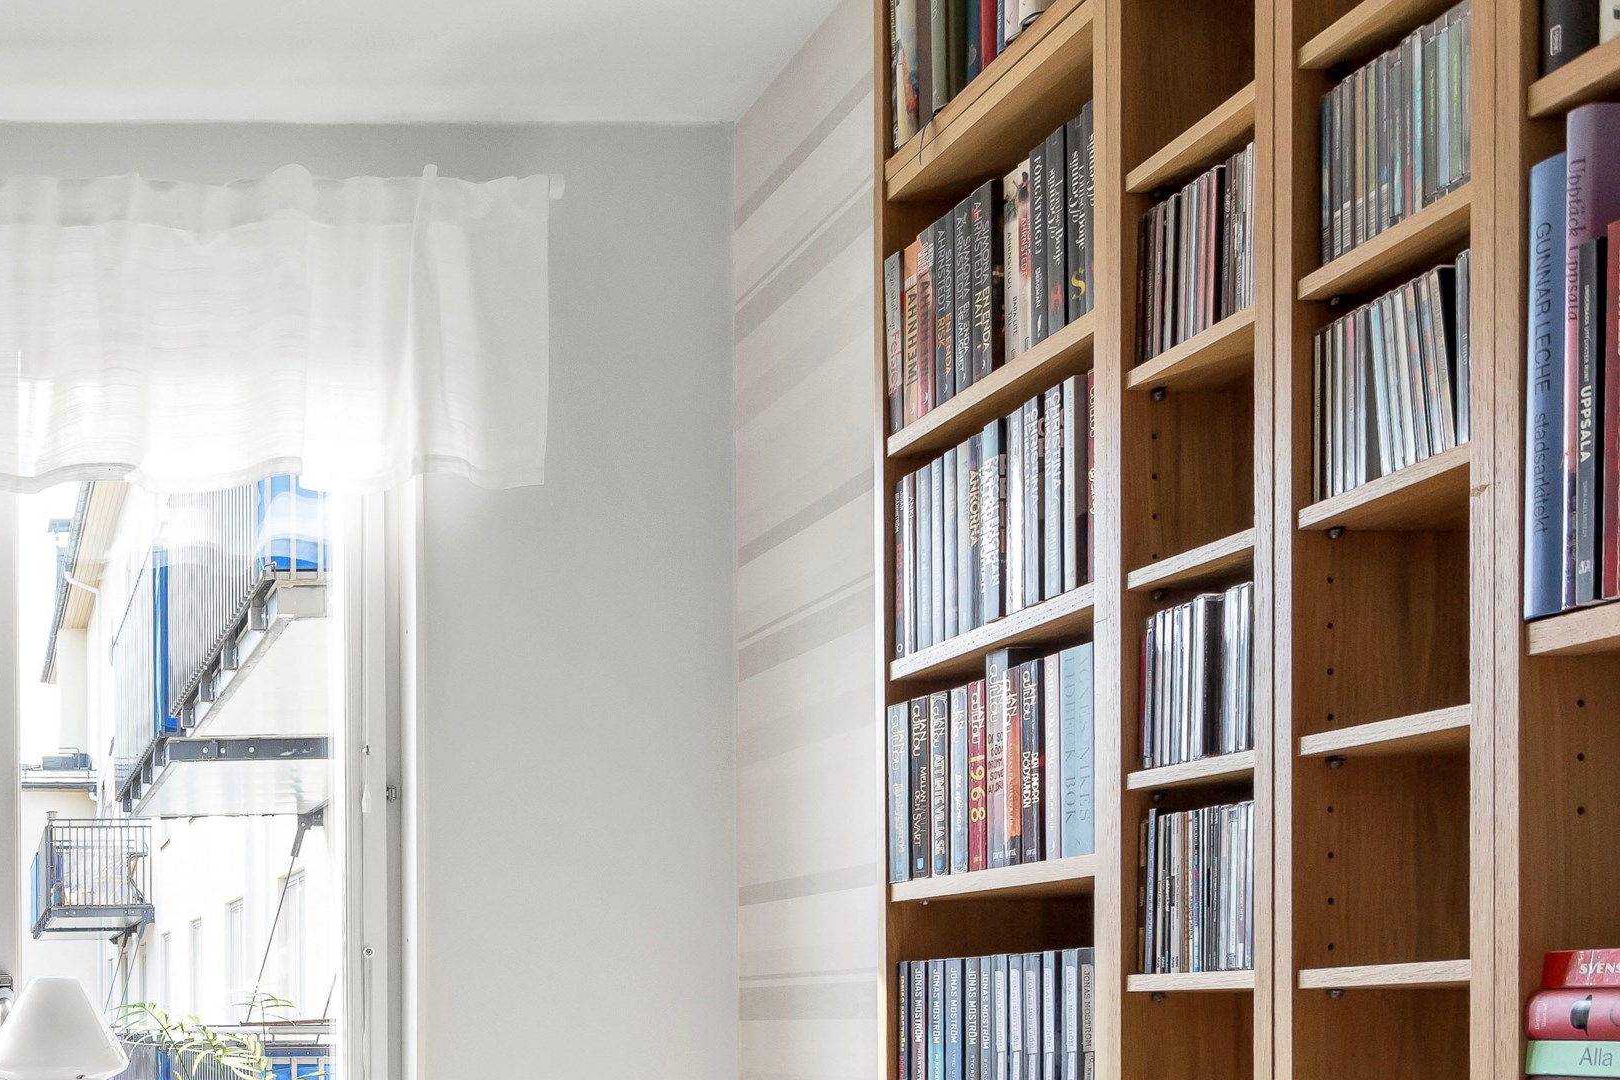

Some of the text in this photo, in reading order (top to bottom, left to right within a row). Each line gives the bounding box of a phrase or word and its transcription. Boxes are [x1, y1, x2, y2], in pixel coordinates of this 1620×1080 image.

[1567, 156, 1589, 238] Upptäck
[955, 218, 964, 301] AHRNSTEDT
[962, 236, 971, 301] SIMONA
[974, 202, 982, 286] AHRNSTEDT
[982, 221, 990, 281] SIMONA
[937, 230, 946, 312] AHRNSTEDT
[945, 250, 953, 309] SIMONA
[937, 317, 946, 347] RISK
[974, 291, 982, 328] NATT
[982, 286, 991, 353] EN ENDA
[1533, 221, 1552, 535] GUNNAR LECHE stadsarkitekt
[1051, 392, 1061, 491] CHRISTINA
[1580, 385, 1593, 463] UPPSALA
[972, 693, 980, 744] GUILLOU
[989, 664, 999, 722] GUILLOU
[1023, 671, 1031, 720] GUILLOU
[892, 715, 900, 770] GUILLOU
[913, 706, 921, 757] GUILLOU
[932, 706, 940, 748] GUILLOU
[935, 754, 944, 777] ATT
[971, 755, 986, 822] 1968
[935, 778, 944, 805] INTE
[1065, 777, 1077, 824] BOK
[913, 814, 922, 848] SVART
[935, 839, 944, 855] SE
[915, 1001, 923, 1042] MOSTRÖM
[933, 1001, 941, 1043] MOSTRÖM
[969, 1001, 977, 1044] MOSTRÖM
[1084, 1002, 1092, 1047] MOSTRÖM
[1579, 1048, 1613, 1067] Alla
